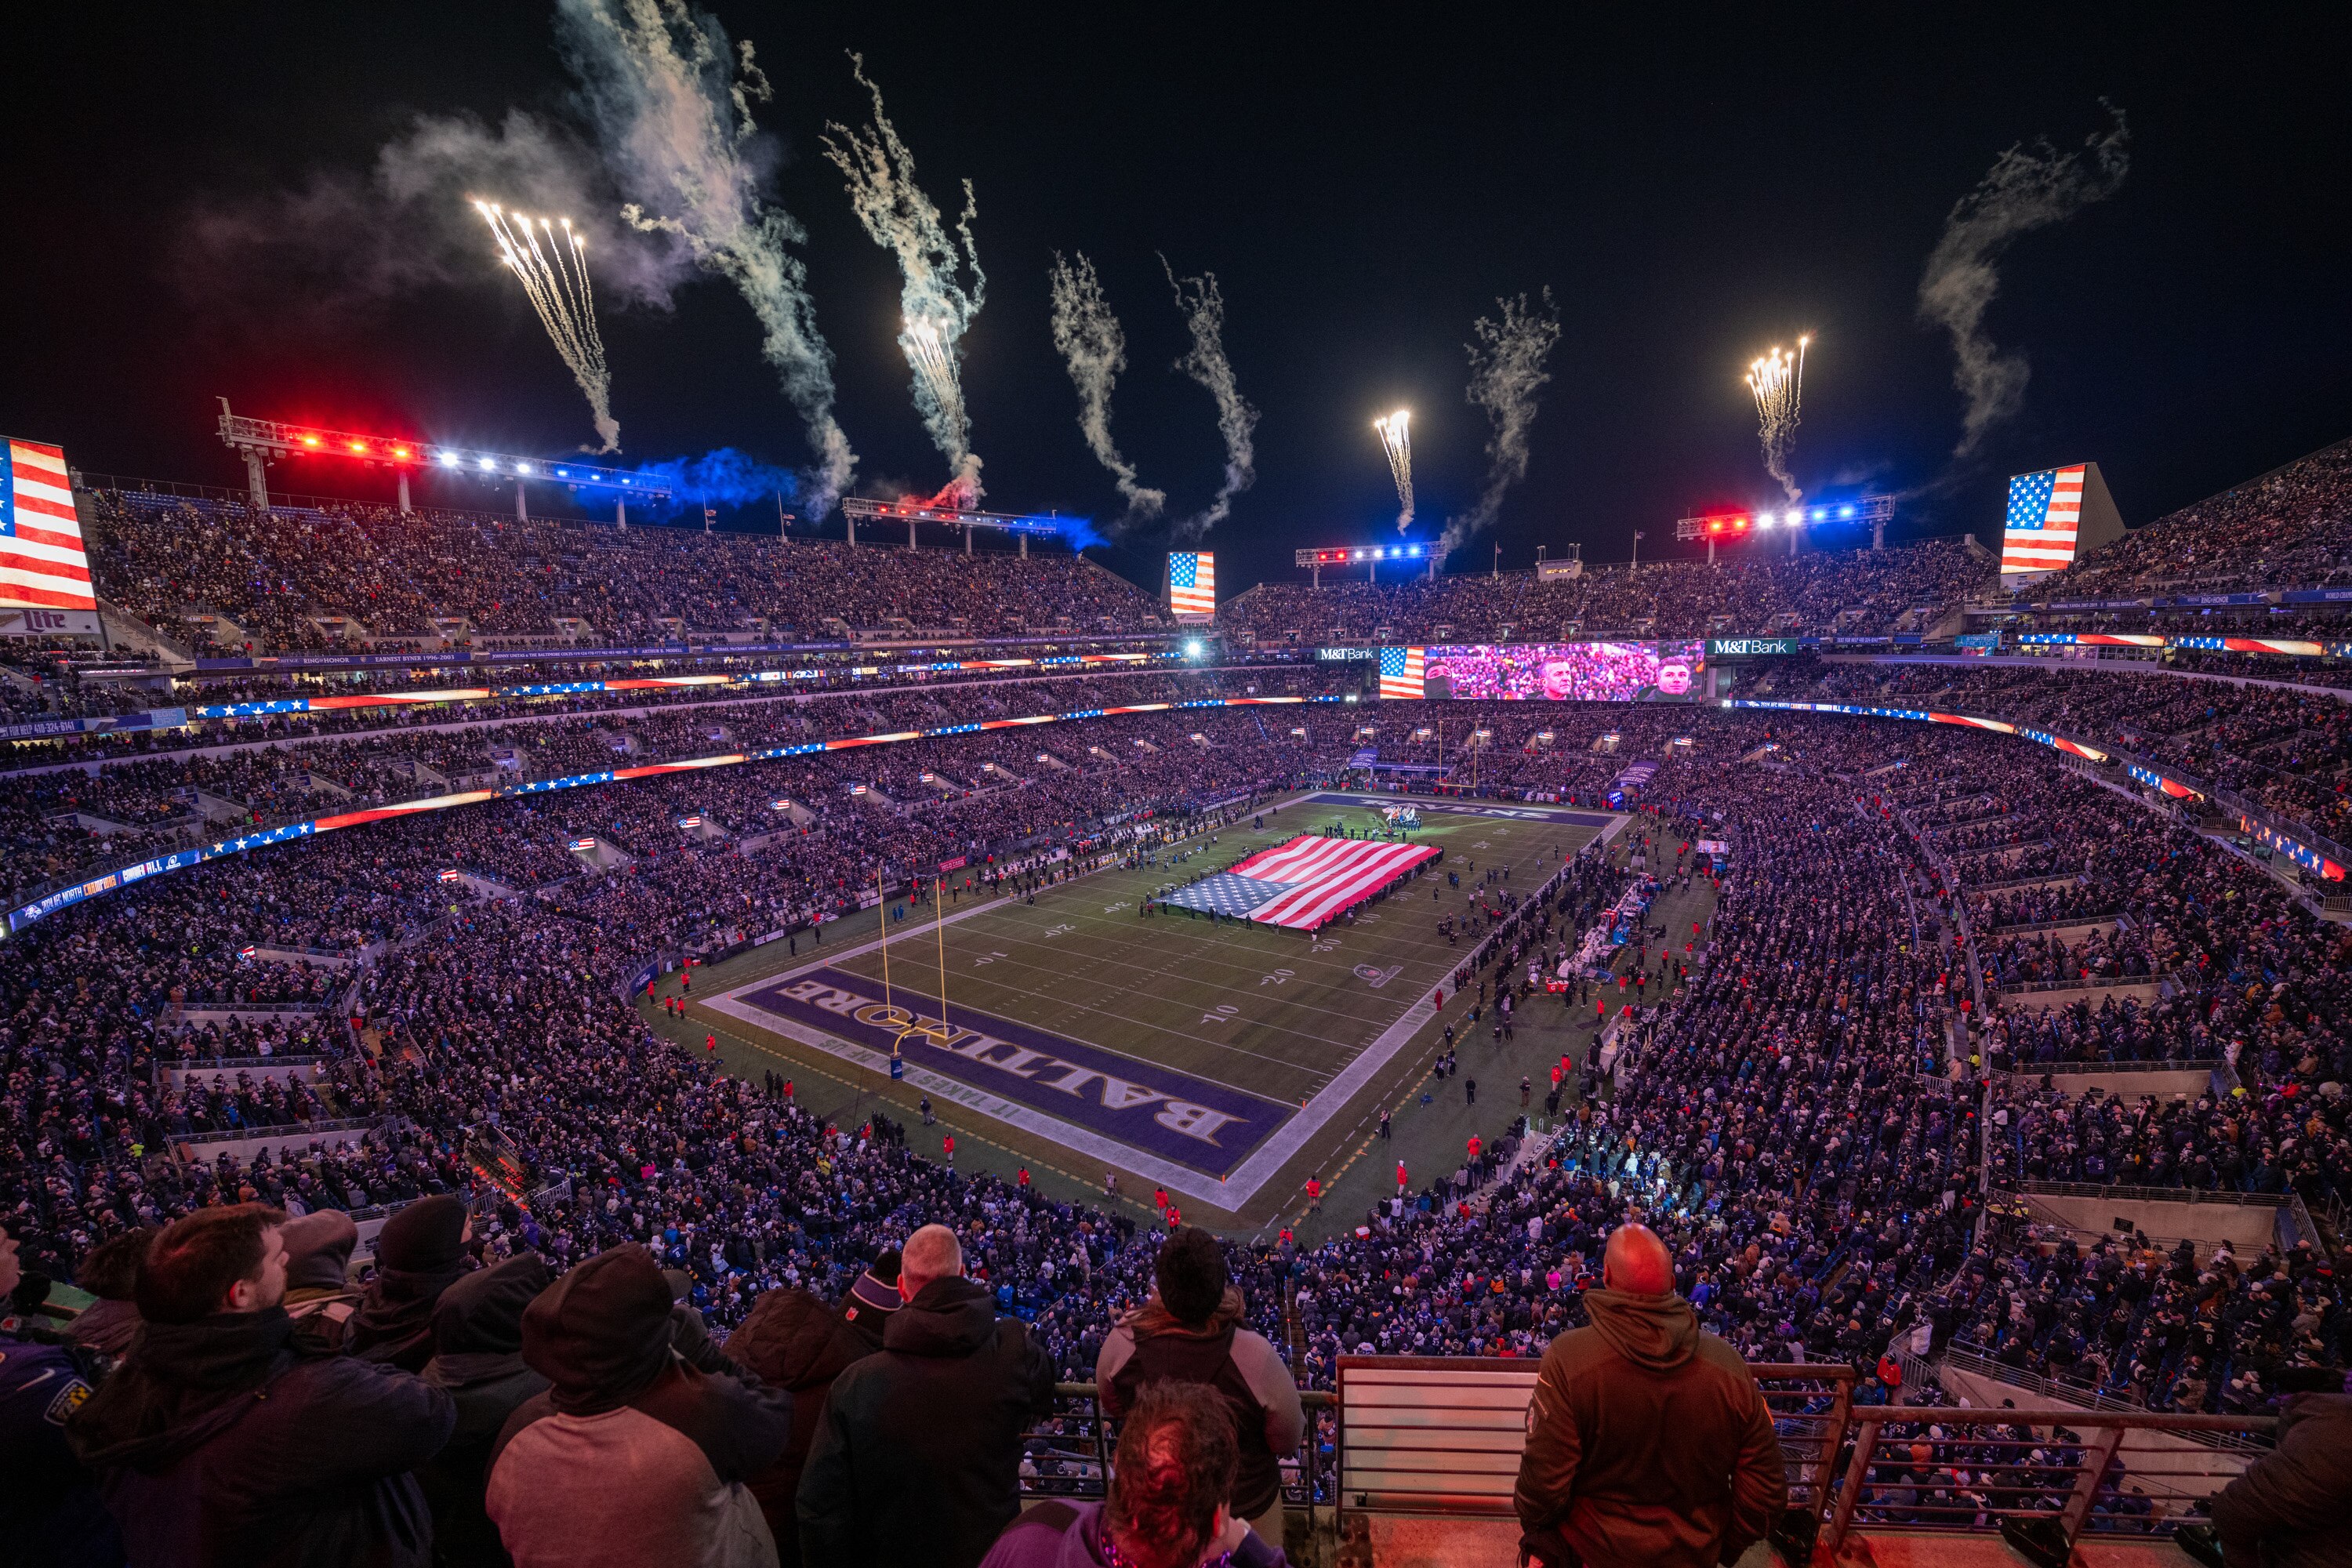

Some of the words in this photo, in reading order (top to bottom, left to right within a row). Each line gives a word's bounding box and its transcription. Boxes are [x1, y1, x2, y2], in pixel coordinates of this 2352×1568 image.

[21, 610, 67, 633] Lite
[1321, 648, 1348, 660] M&T
[1348, 648, 1374, 659] Bank
[1715, 640, 1751, 654] M&T
[1751, 639, 1787, 653] Bank
[9, 725, 20, 737] FOR
[20, 724, 33, 735] HELP
[34, 720, 75, 734] 410-324-6141
[1360, 798, 1551, 818] RAVENS
[147, 859, 162, 875] ALL
[42, 899, 54, 913] 2024
[53, 894, 63, 907] AFC
[62, 887, 83, 905] NORTH
[82, 874, 117, 897] CHAMPIONS
[1396, 891, 1414, 901] 50
[1104, 902, 1132, 912] 30
[1045, 924, 1076, 936] 20
[1313, 938, 1342, 953] 30
[1264, 968, 1295, 985] 20
[1204, 1004, 1240, 1024] 10
[818, 1039, 848, 1053] US
[775, 980, 1252, 1148] BALTIMORE
[916, 1074, 988, 1108] TAKES
[989, 1103, 1021, 1119] IT
[2206, 1334, 2212, 1345] 8
[1896, 1424, 1907, 1434] 52
